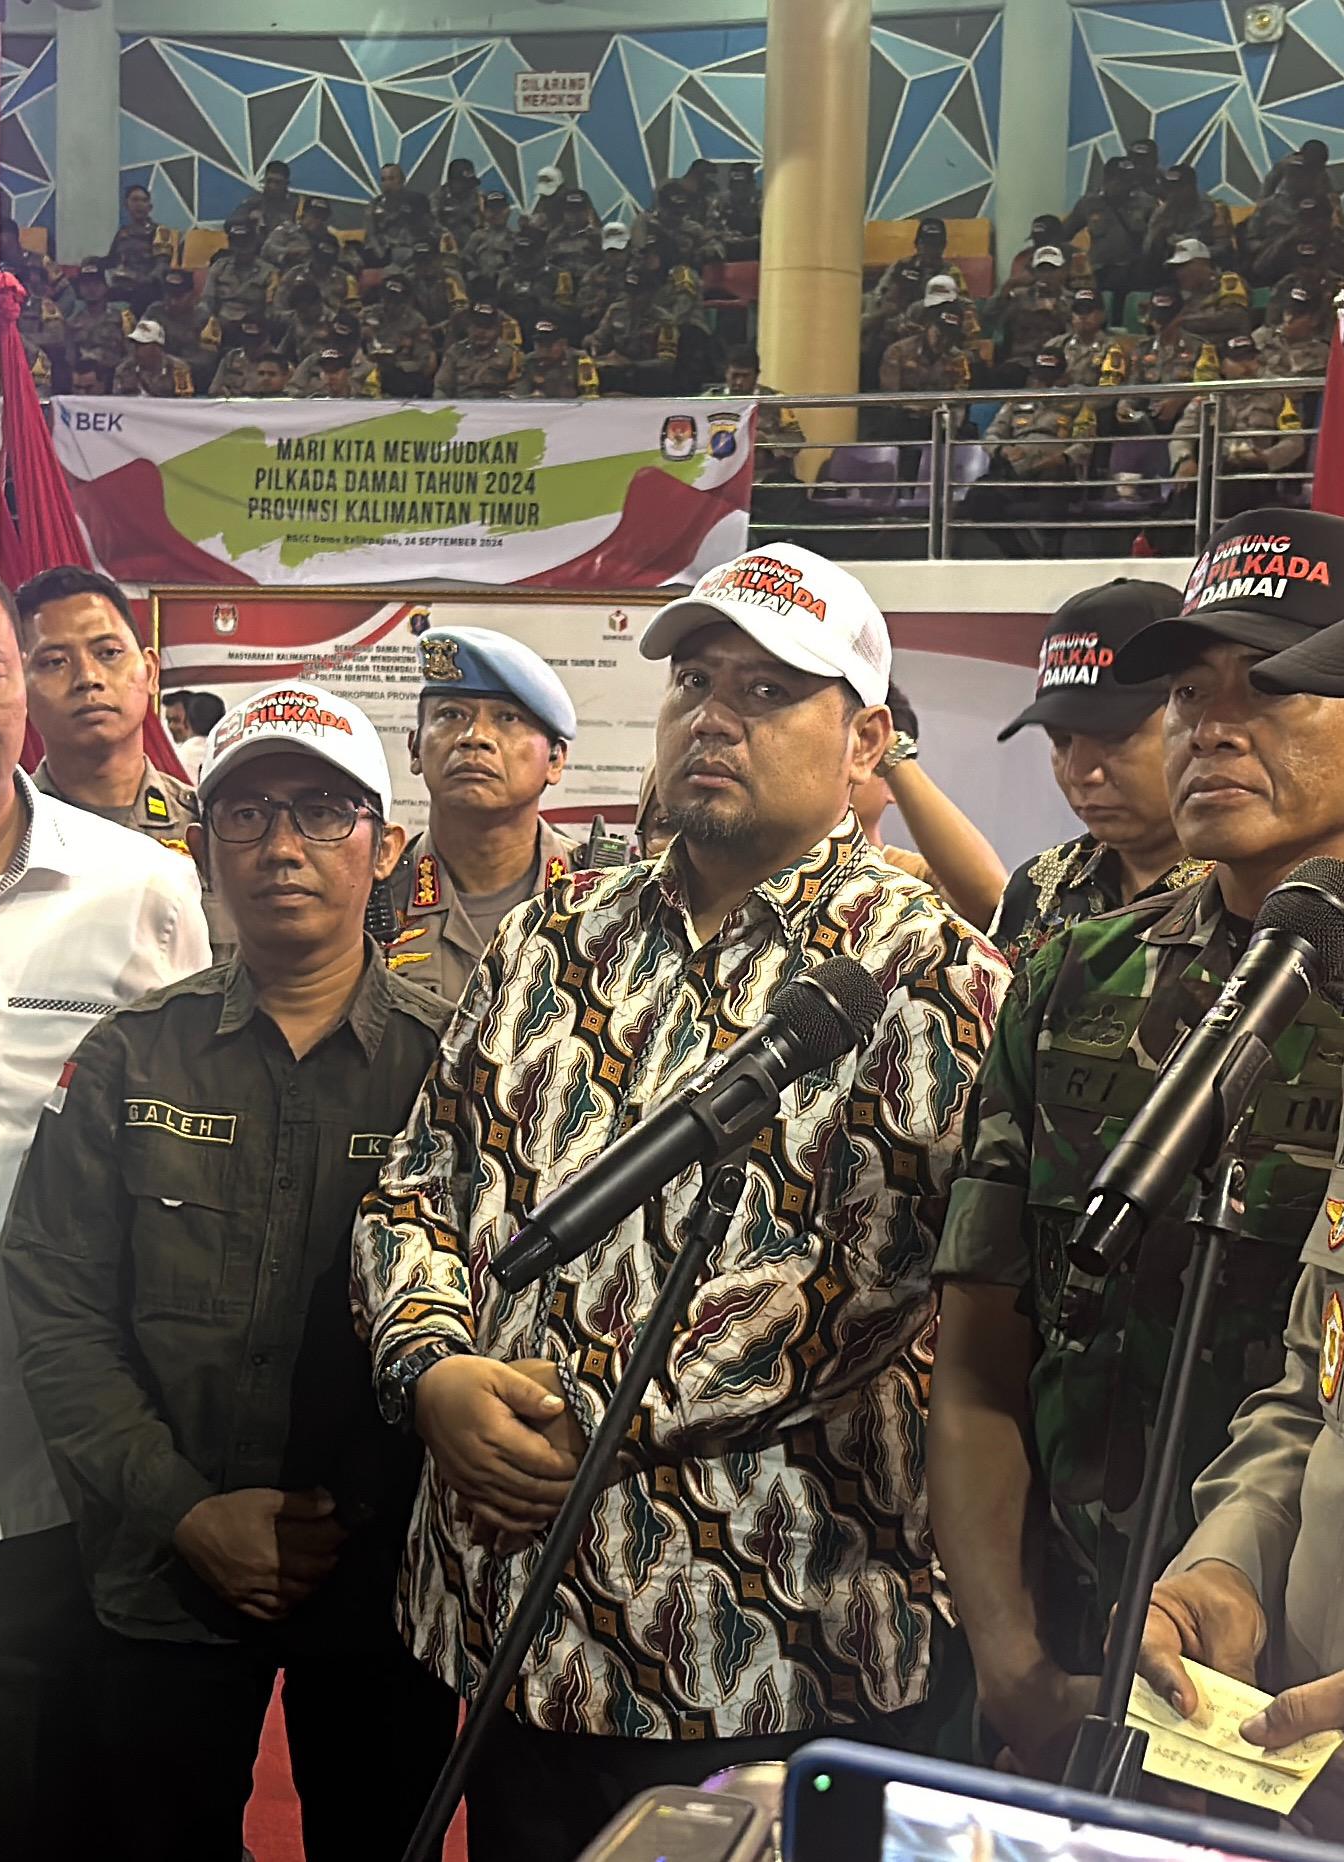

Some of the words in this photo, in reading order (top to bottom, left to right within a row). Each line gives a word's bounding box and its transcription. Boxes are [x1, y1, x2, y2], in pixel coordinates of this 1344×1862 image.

[76, 412, 123, 432] BEK
[276, 437, 326, 463] MARI
[332, 439, 376, 463] KITA
[383, 440, 519, 465] MEWUJUDKAN
[255, 467, 338, 491] PILKADA
[344, 470, 408, 494] DAMAI
[415, 471, 479, 495] TAHUN
[485, 471, 537, 495] 2024
[248, 496, 338, 522] PROVINSI
[345, 498, 472, 525] KALIMANTAN
[478, 501, 540, 526] TIMUR
[404, 538, 417, 546] 24
[419, 538, 478, 547] SEPTEMBER
[479, 539, 504, 547] 2024
[1212, 534, 1292, 565] DUKUNG
[1207, 553, 1331, 587] PILKADA
[714, 581, 794, 617] DAMAI
[719, 570, 827, 622] PILKADA
[1197, 576, 1288, 610] DAMAI
[1046, 647, 1114, 669] PILKAD
[1042, 664, 1099, 688] DAMAI
[242, 720, 325, 738] DAMAI
[244, 705, 353, 736] PILKADA
